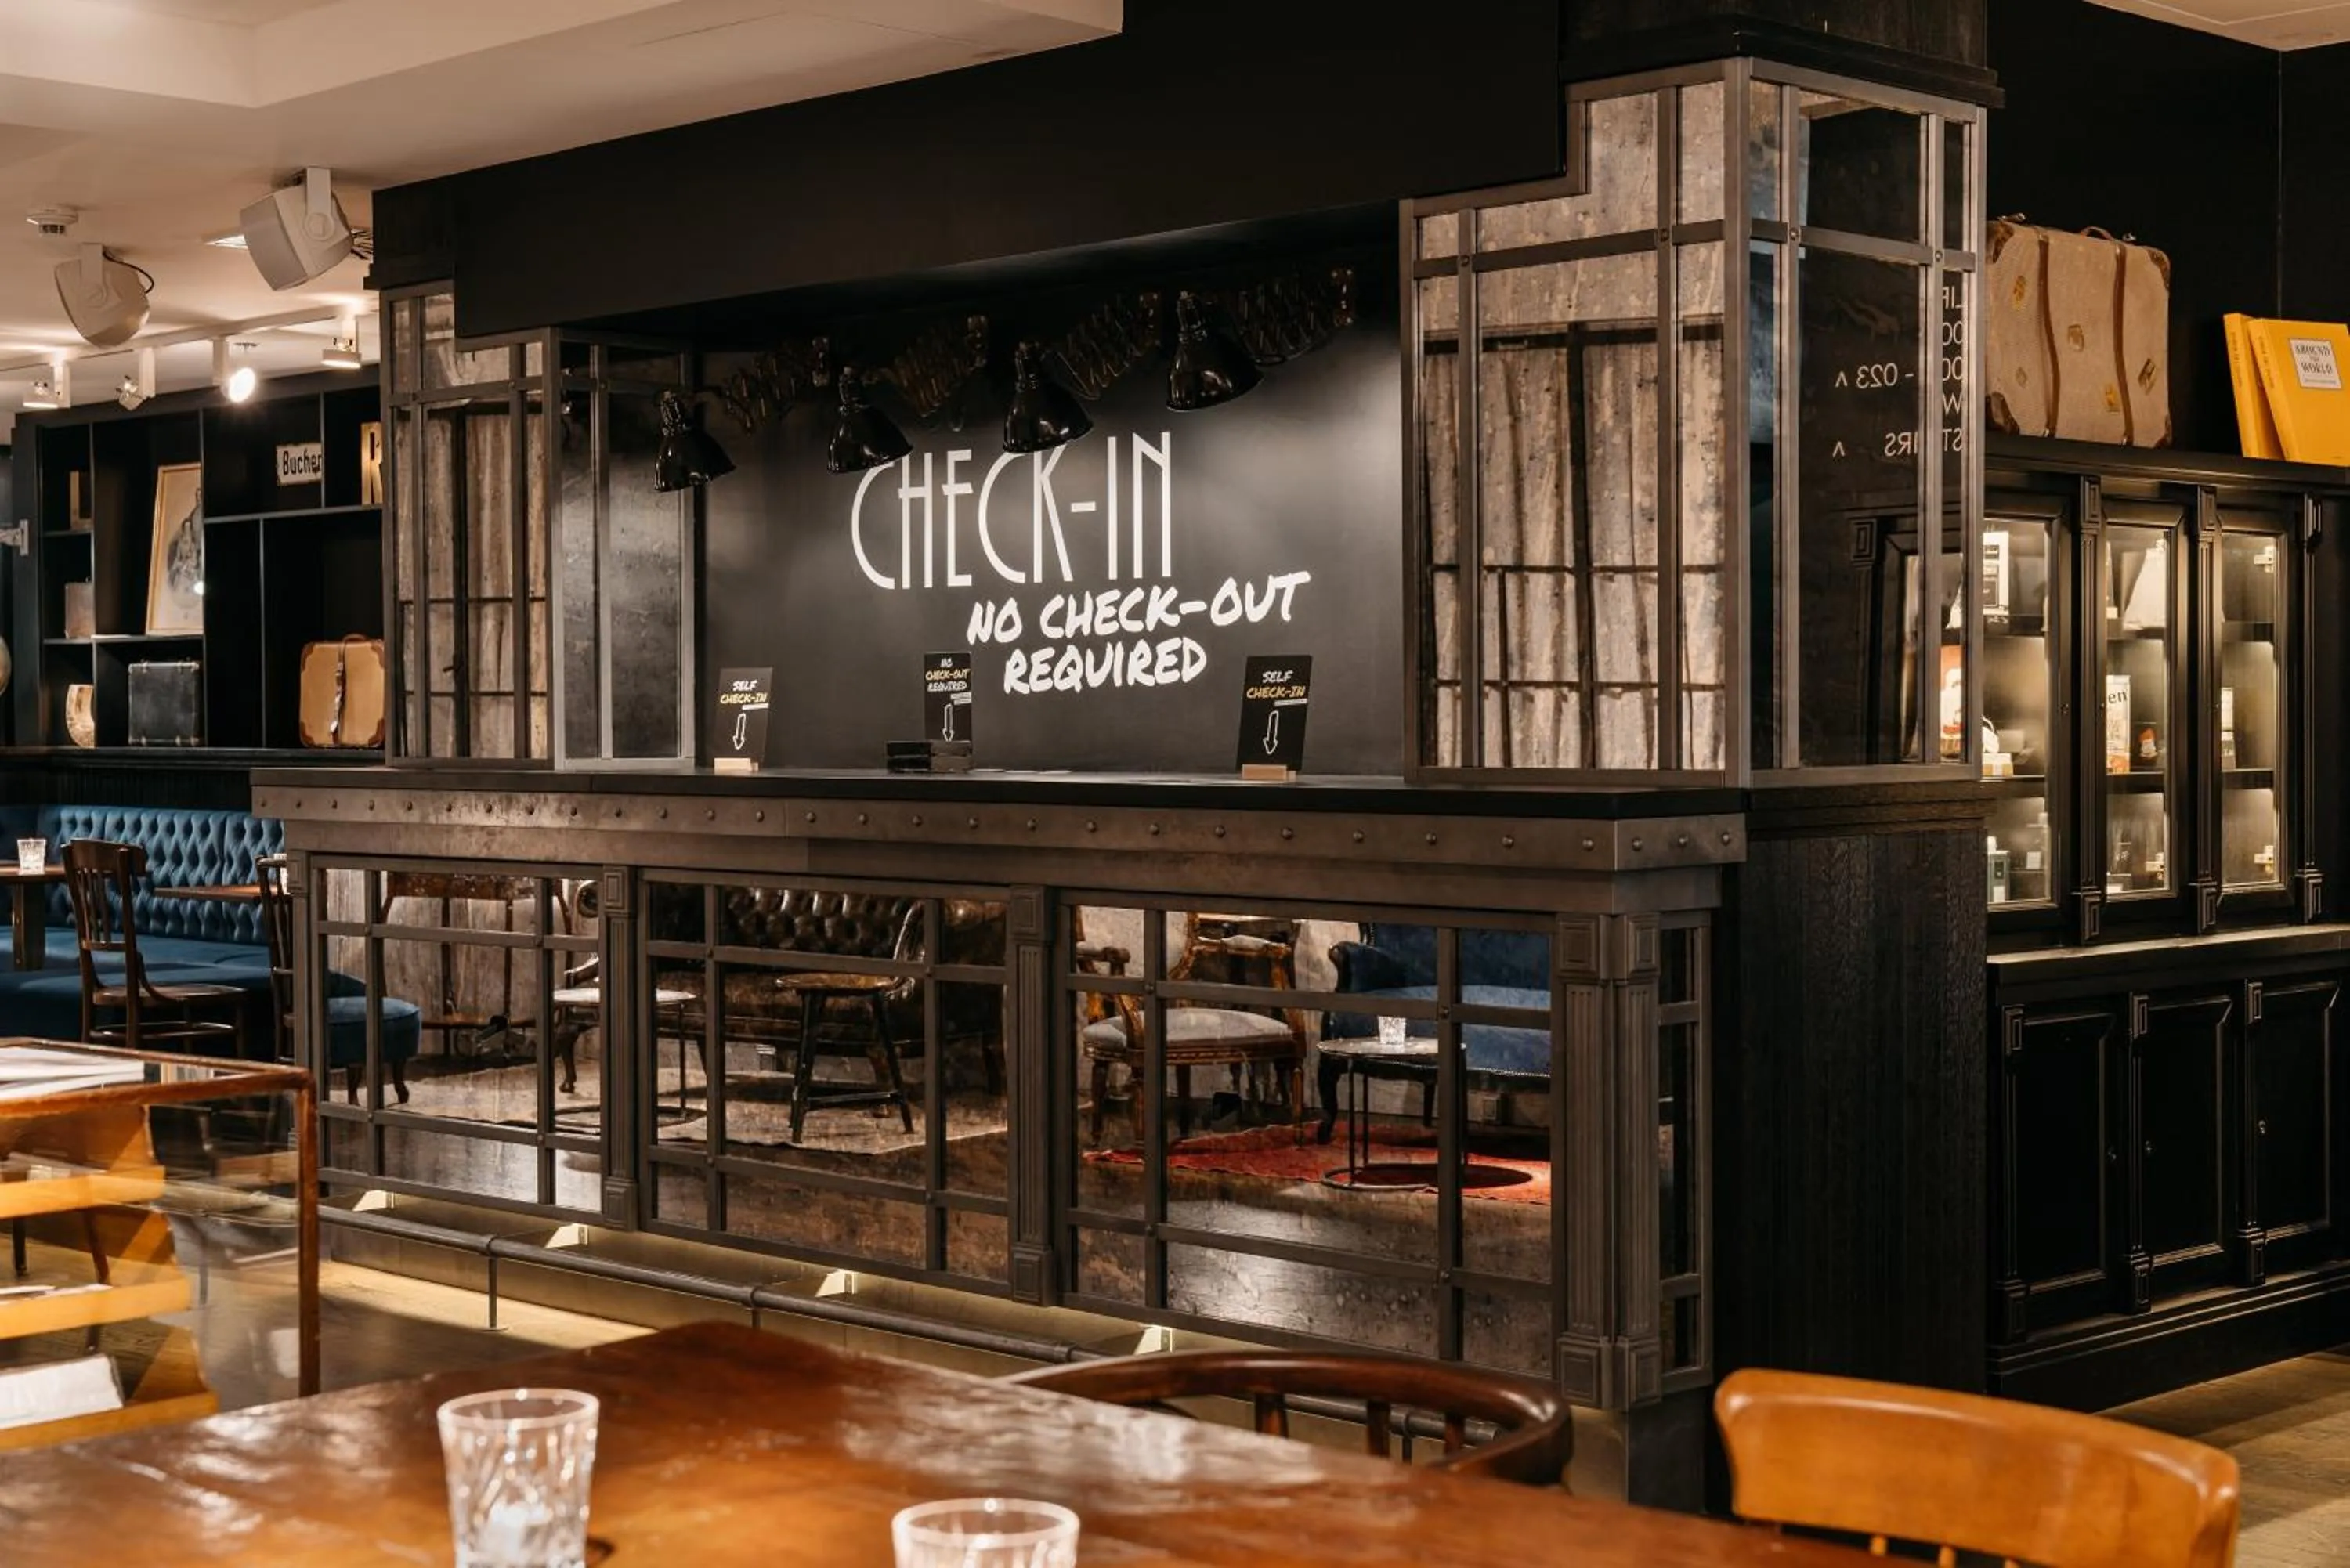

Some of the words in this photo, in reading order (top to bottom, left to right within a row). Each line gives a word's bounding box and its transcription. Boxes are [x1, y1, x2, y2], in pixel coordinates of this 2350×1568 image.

[851, 432, 1171, 590] CHECK-IN
[967, 598, 1023, 645] NO
[1039, 570, 1311, 639] CHECK-OUT
[941, 658, 953, 668] NO
[1003, 636, 1207, 695] REQUIRED
[925, 668, 971, 681] CHECK-OUT
[1262, 670, 1294, 683] SELF
[732, 679, 758, 692] SELF
[927, 681, 967, 692] REQUIRED
[1246, 685, 1306, 699] CHECK-IN
[720, 692, 768, 704] CHECK-IN
